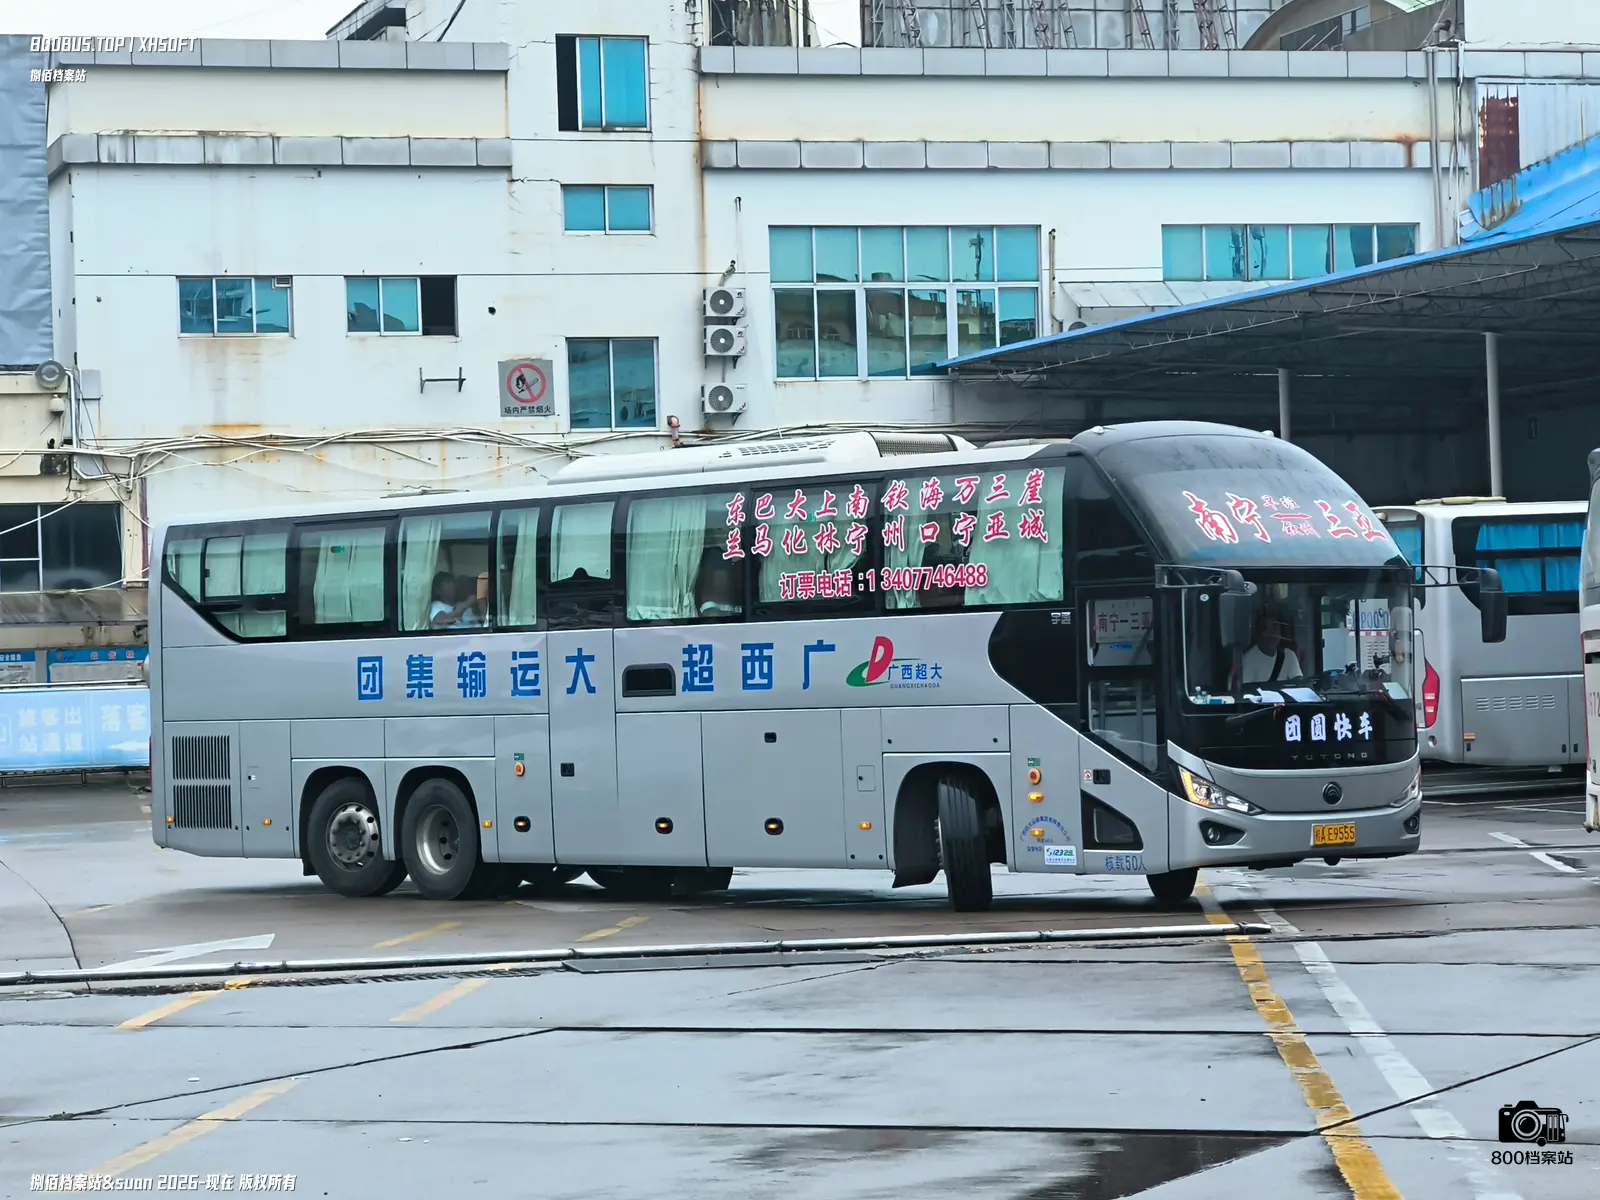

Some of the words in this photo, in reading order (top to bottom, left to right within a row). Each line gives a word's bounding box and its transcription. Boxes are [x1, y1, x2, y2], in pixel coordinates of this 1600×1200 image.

[504, 405, 551, 414] 场内严禁烟火
[888, 663, 942, 681] 广西超大
[1291, 752, 1368, 761] YUTONG
[1105, 855, 1148, 872] 核载50人
